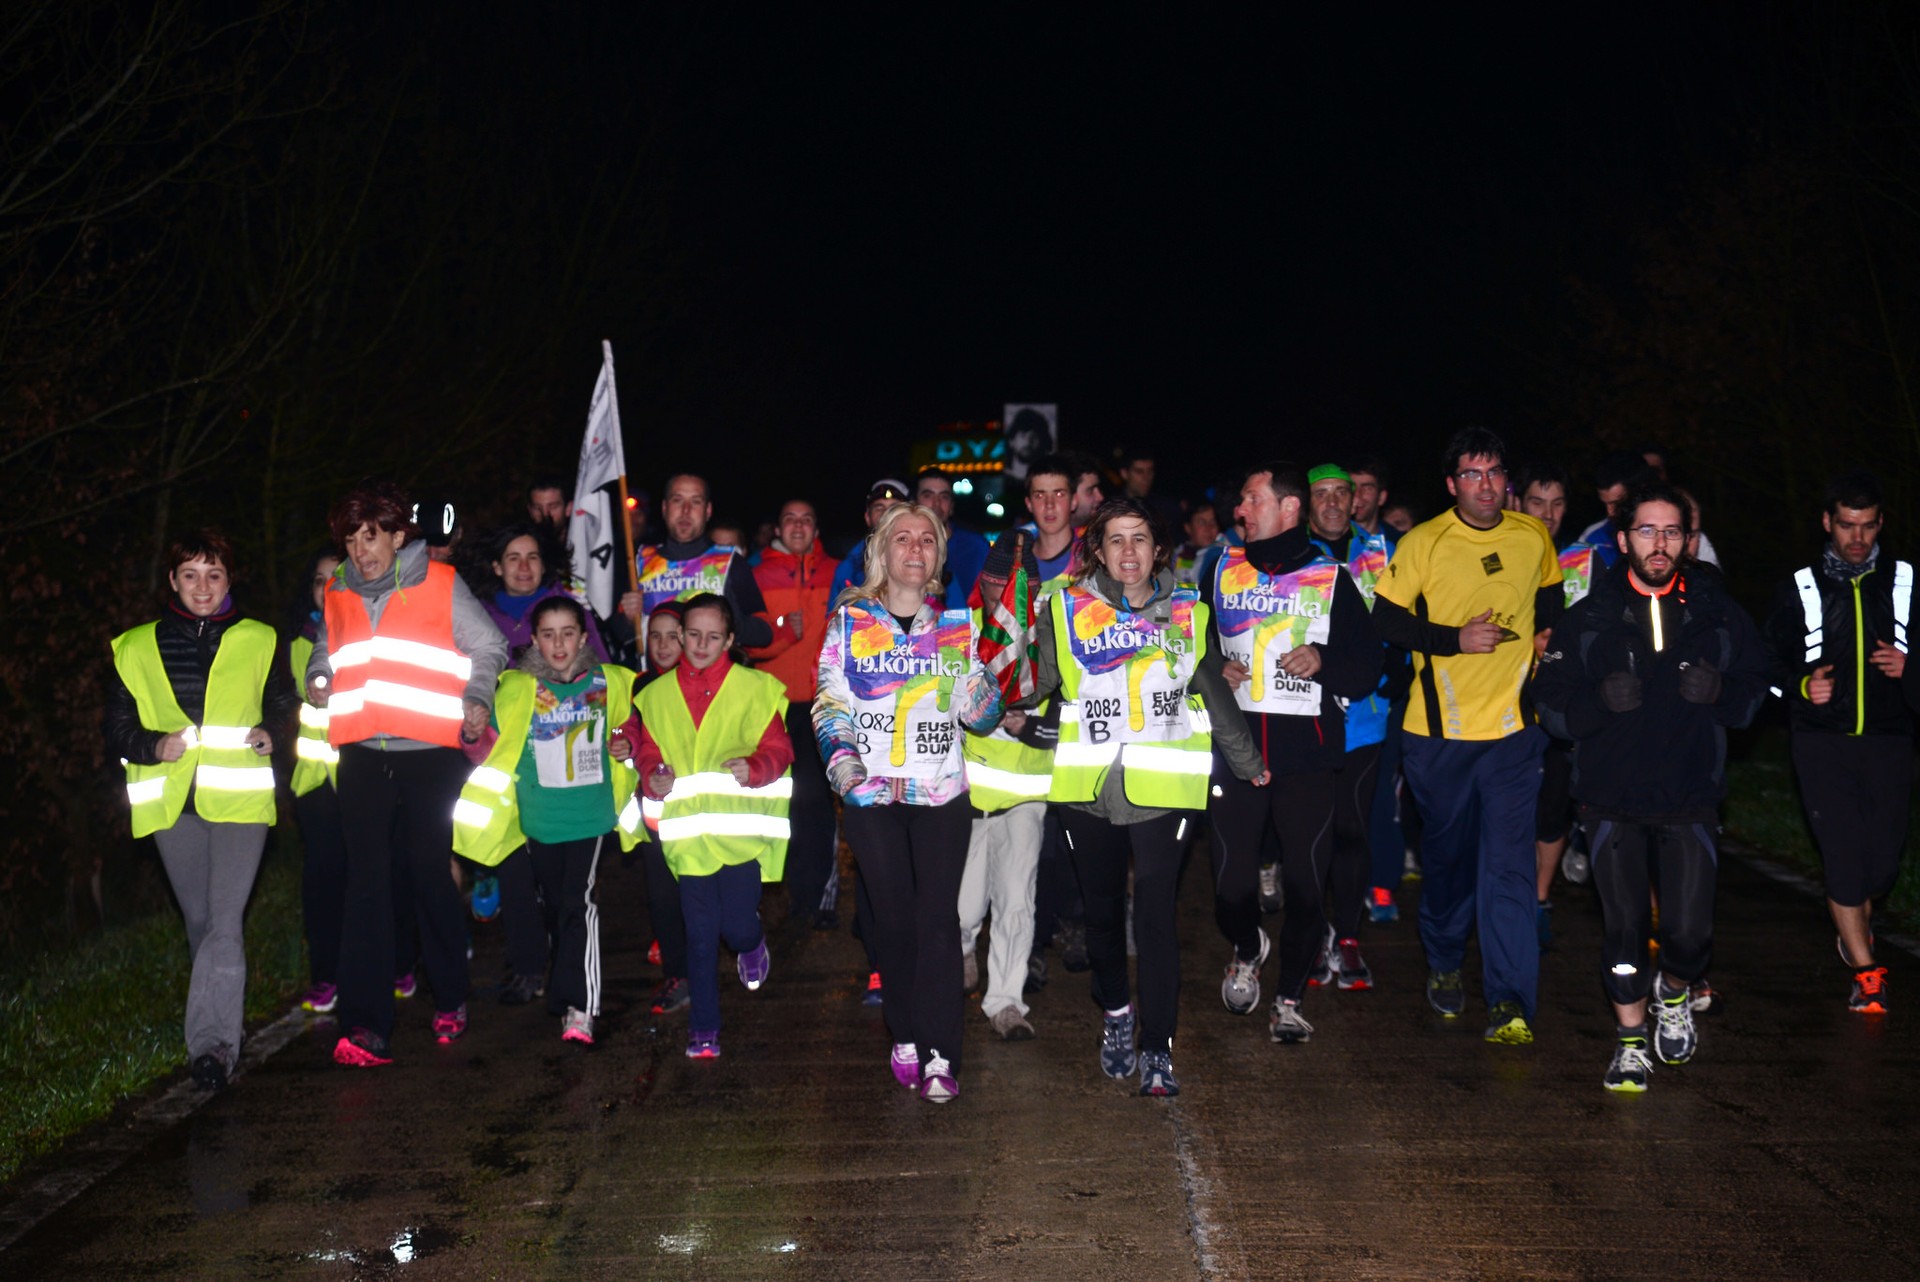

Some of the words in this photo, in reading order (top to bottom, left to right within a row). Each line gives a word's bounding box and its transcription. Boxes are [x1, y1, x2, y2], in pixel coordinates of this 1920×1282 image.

[1252, 581, 1277, 595] aek
[1222, 588, 1321, 619] 19.korrika
[890, 640, 915, 656] aek
[853, 650, 963, 678] 19.korrika
[1275, 680, 1311, 693] DUN!
[1085, 698, 1121, 719] 2082
[1088, 720, 1111, 744] B
[857, 732, 871, 754] B
